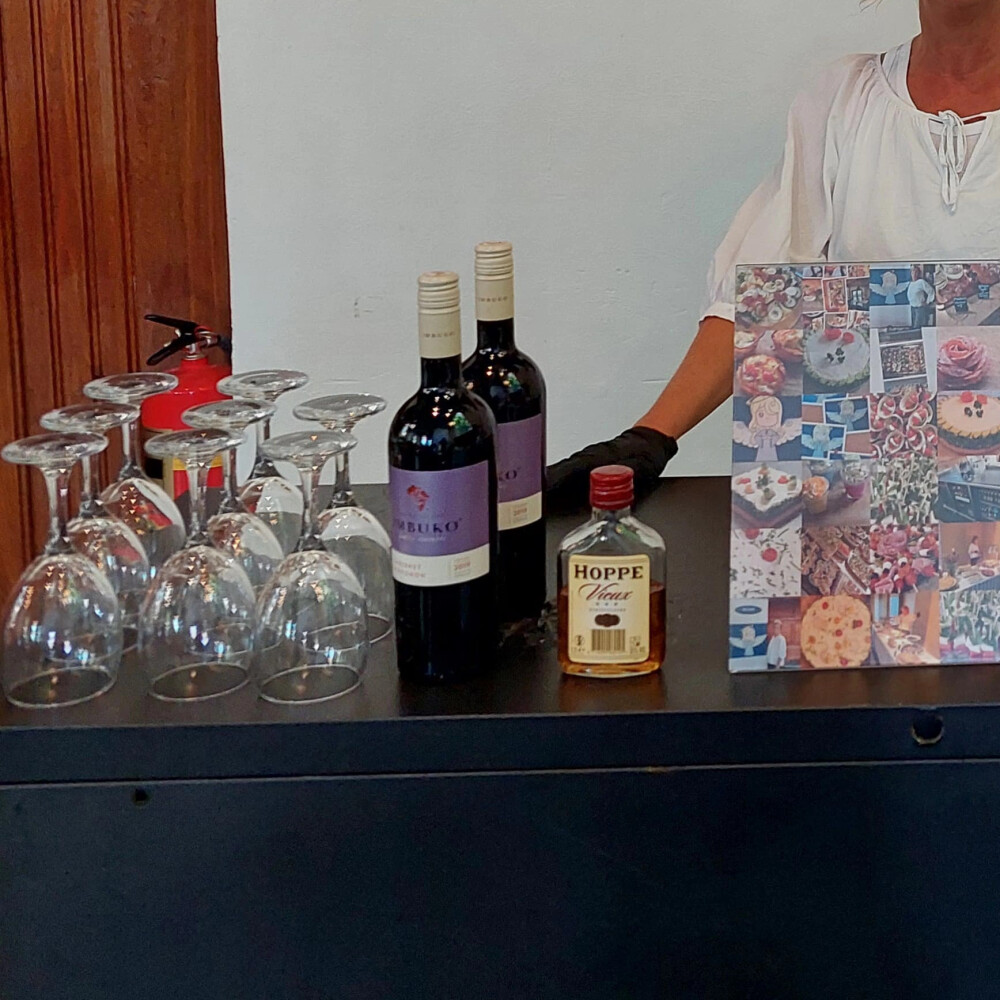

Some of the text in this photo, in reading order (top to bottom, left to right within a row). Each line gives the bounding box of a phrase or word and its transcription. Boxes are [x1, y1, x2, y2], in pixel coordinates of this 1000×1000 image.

[393, 517, 459, 534] MBUKO
[574, 564, 644, 580] HOPPE
[578, 582, 634, 601] Vieux
